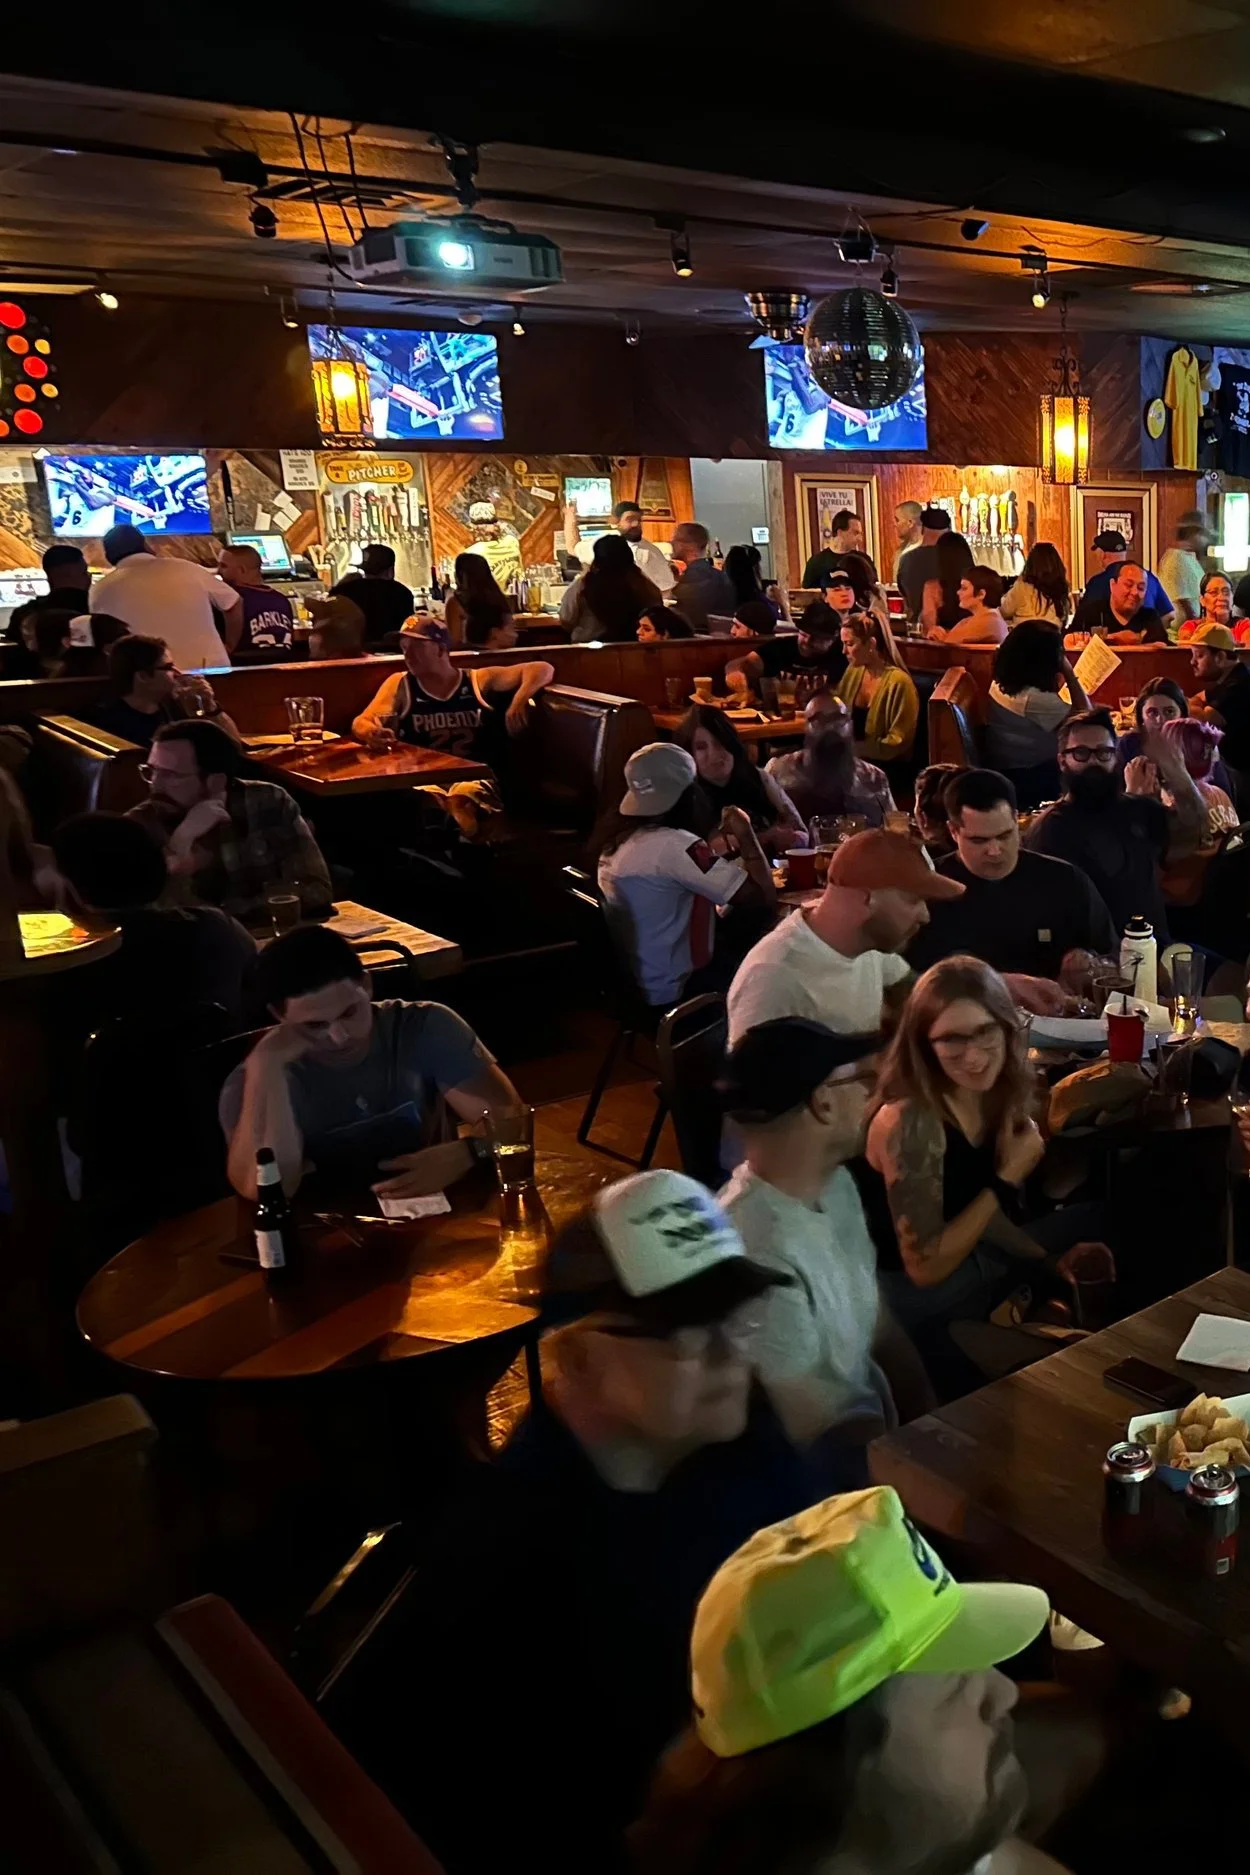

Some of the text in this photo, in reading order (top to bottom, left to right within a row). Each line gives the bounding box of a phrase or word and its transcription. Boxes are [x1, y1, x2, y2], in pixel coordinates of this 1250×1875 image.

[347, 465, 397, 482] PITCHER
[250, 611, 293, 636] BARKLE
[412, 708, 483, 733] PHOENIX
